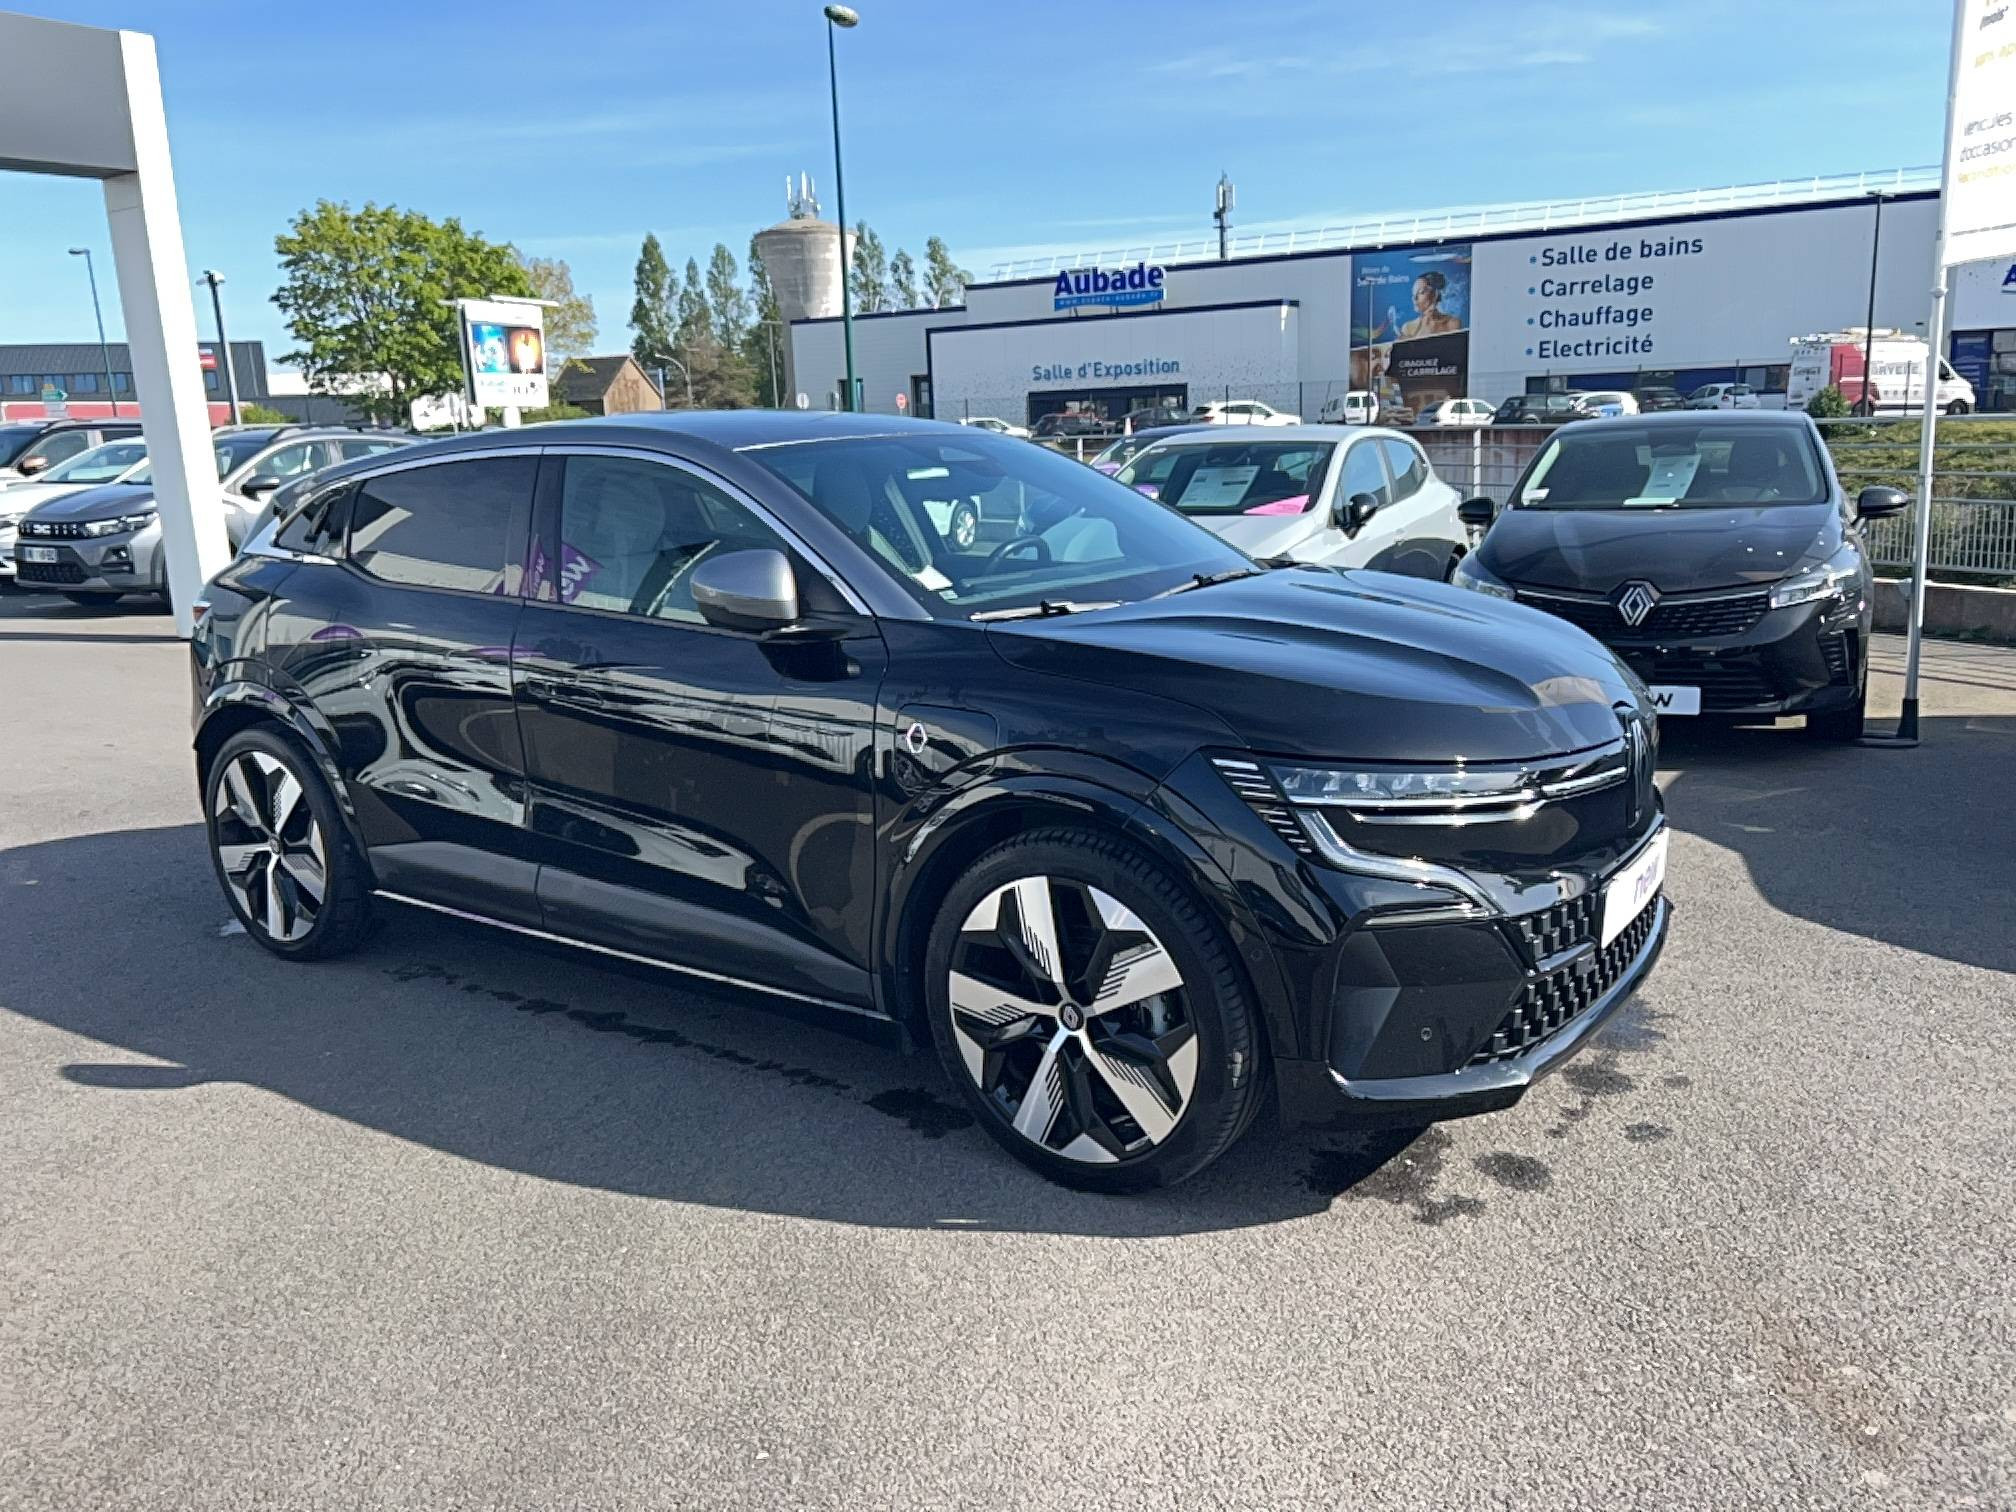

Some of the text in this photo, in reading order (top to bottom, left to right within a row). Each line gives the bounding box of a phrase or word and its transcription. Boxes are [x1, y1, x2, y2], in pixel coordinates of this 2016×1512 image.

[1541, 236, 1704, 267] Salle de bains
[1054, 261, 1164, 297] Aubade
[1540, 274, 1654, 297] Carrelage
[1539, 305, 1653, 328] Chauffage
[1539, 333, 1653, 359] Electricité
[1032, 358, 1180, 381] Salle d'Exposition
